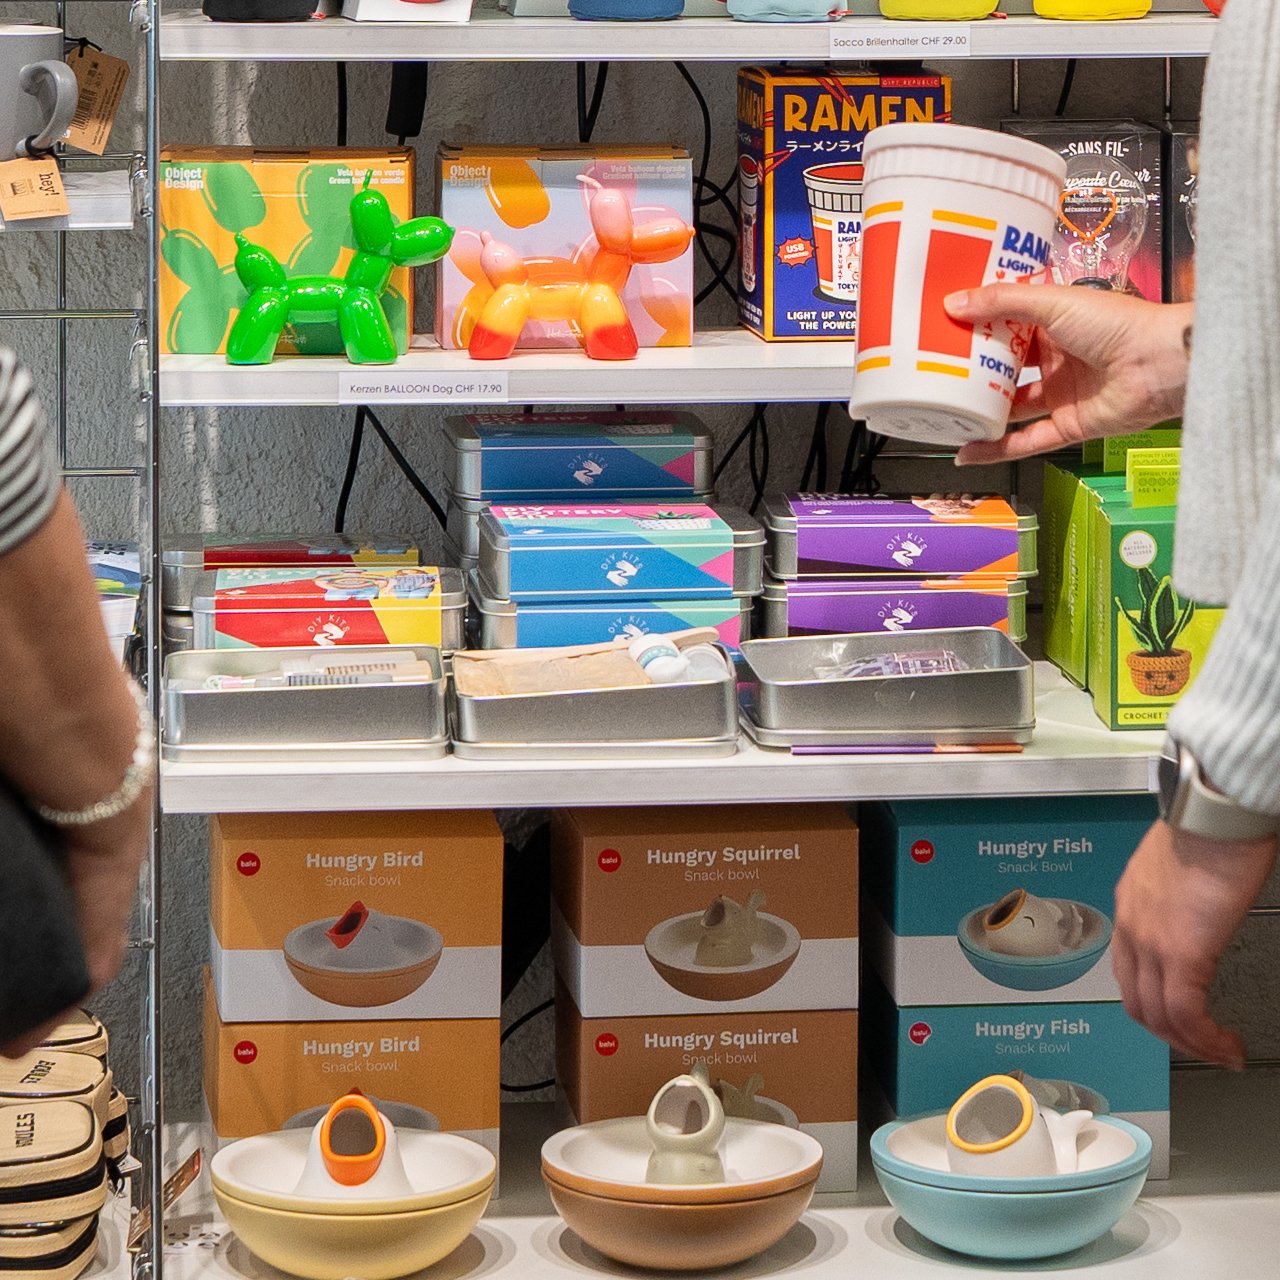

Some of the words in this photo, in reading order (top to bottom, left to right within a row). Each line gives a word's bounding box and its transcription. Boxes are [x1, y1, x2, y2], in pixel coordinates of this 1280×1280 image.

[834, 38, 864, 47] Sacco
[866, 37, 919, 46] Brillenhalter
[921, 37, 940, 45] CHF
[943, 36, 967, 45] 29.00
[784, 94, 934, 132] RAMEN
[165, 167, 202, 180] Object
[450, 165, 487, 178] Object
[39, 171, 60, 197] hey!
[165, 178, 204, 190] Design
[450, 176, 489, 188] Design
[786, 243, 804, 253] USB
[998, 257, 1035, 275] LIGHT
[787, 311, 817, 320] LIGHT
[822, 311, 834, 319] UP
[799, 322, 818, 330] THE
[823, 321, 857, 330] POWER
[980, 355, 1014, 379] TOKYO
[350, 385, 382, 393] Kerzen
[385, 384, 430, 393] BALLOON
[433, 384, 453, 395] Dog
[455, 384, 475, 393] CHF
[478, 384, 502, 393] 17.90
[886, 534, 901, 551] DIY
[907, 532, 928, 551] KITS
[600, 552, 616, 570] DIY
[622, 550, 643, 570] KITS
[1124, 712, 1163, 720] CROCHET
[978, 840, 1047, 859] Hungry
[1053, 838, 1093, 855] Fish
[306, 852, 378, 872] Hungry
[383, 851, 424, 868] Bird
[647, 849, 717, 867] Hungry
[722, 844, 801, 865] Squirrel
[999, 861, 1037, 873] Snack
[1042, 861, 1073, 873] Bowl
[325, 875, 366, 887] Snack
[370, 875, 401, 886] bowl
[684, 870, 724, 882] Snack
[728, 868, 760, 880] bowl
[975, 1021, 1044, 1040] Hungry
[1050, 1019, 1090, 1035] Fish
[644, 1032, 714, 1051] Hungry
[720, 1028, 799, 1049] Squirrel
[303, 1039, 374, 1058] Hungry
[380, 1036, 420, 1053] Bird
[995, 1043, 1034, 1055] Snack
[1039, 1042, 1070, 1054] Bowl
[682, 1054, 722, 1066] Snack
[726, 1052, 758, 1064] bowl
[321, 1061, 362, 1073] Snack
[366, 1060, 398, 1071] bowl
